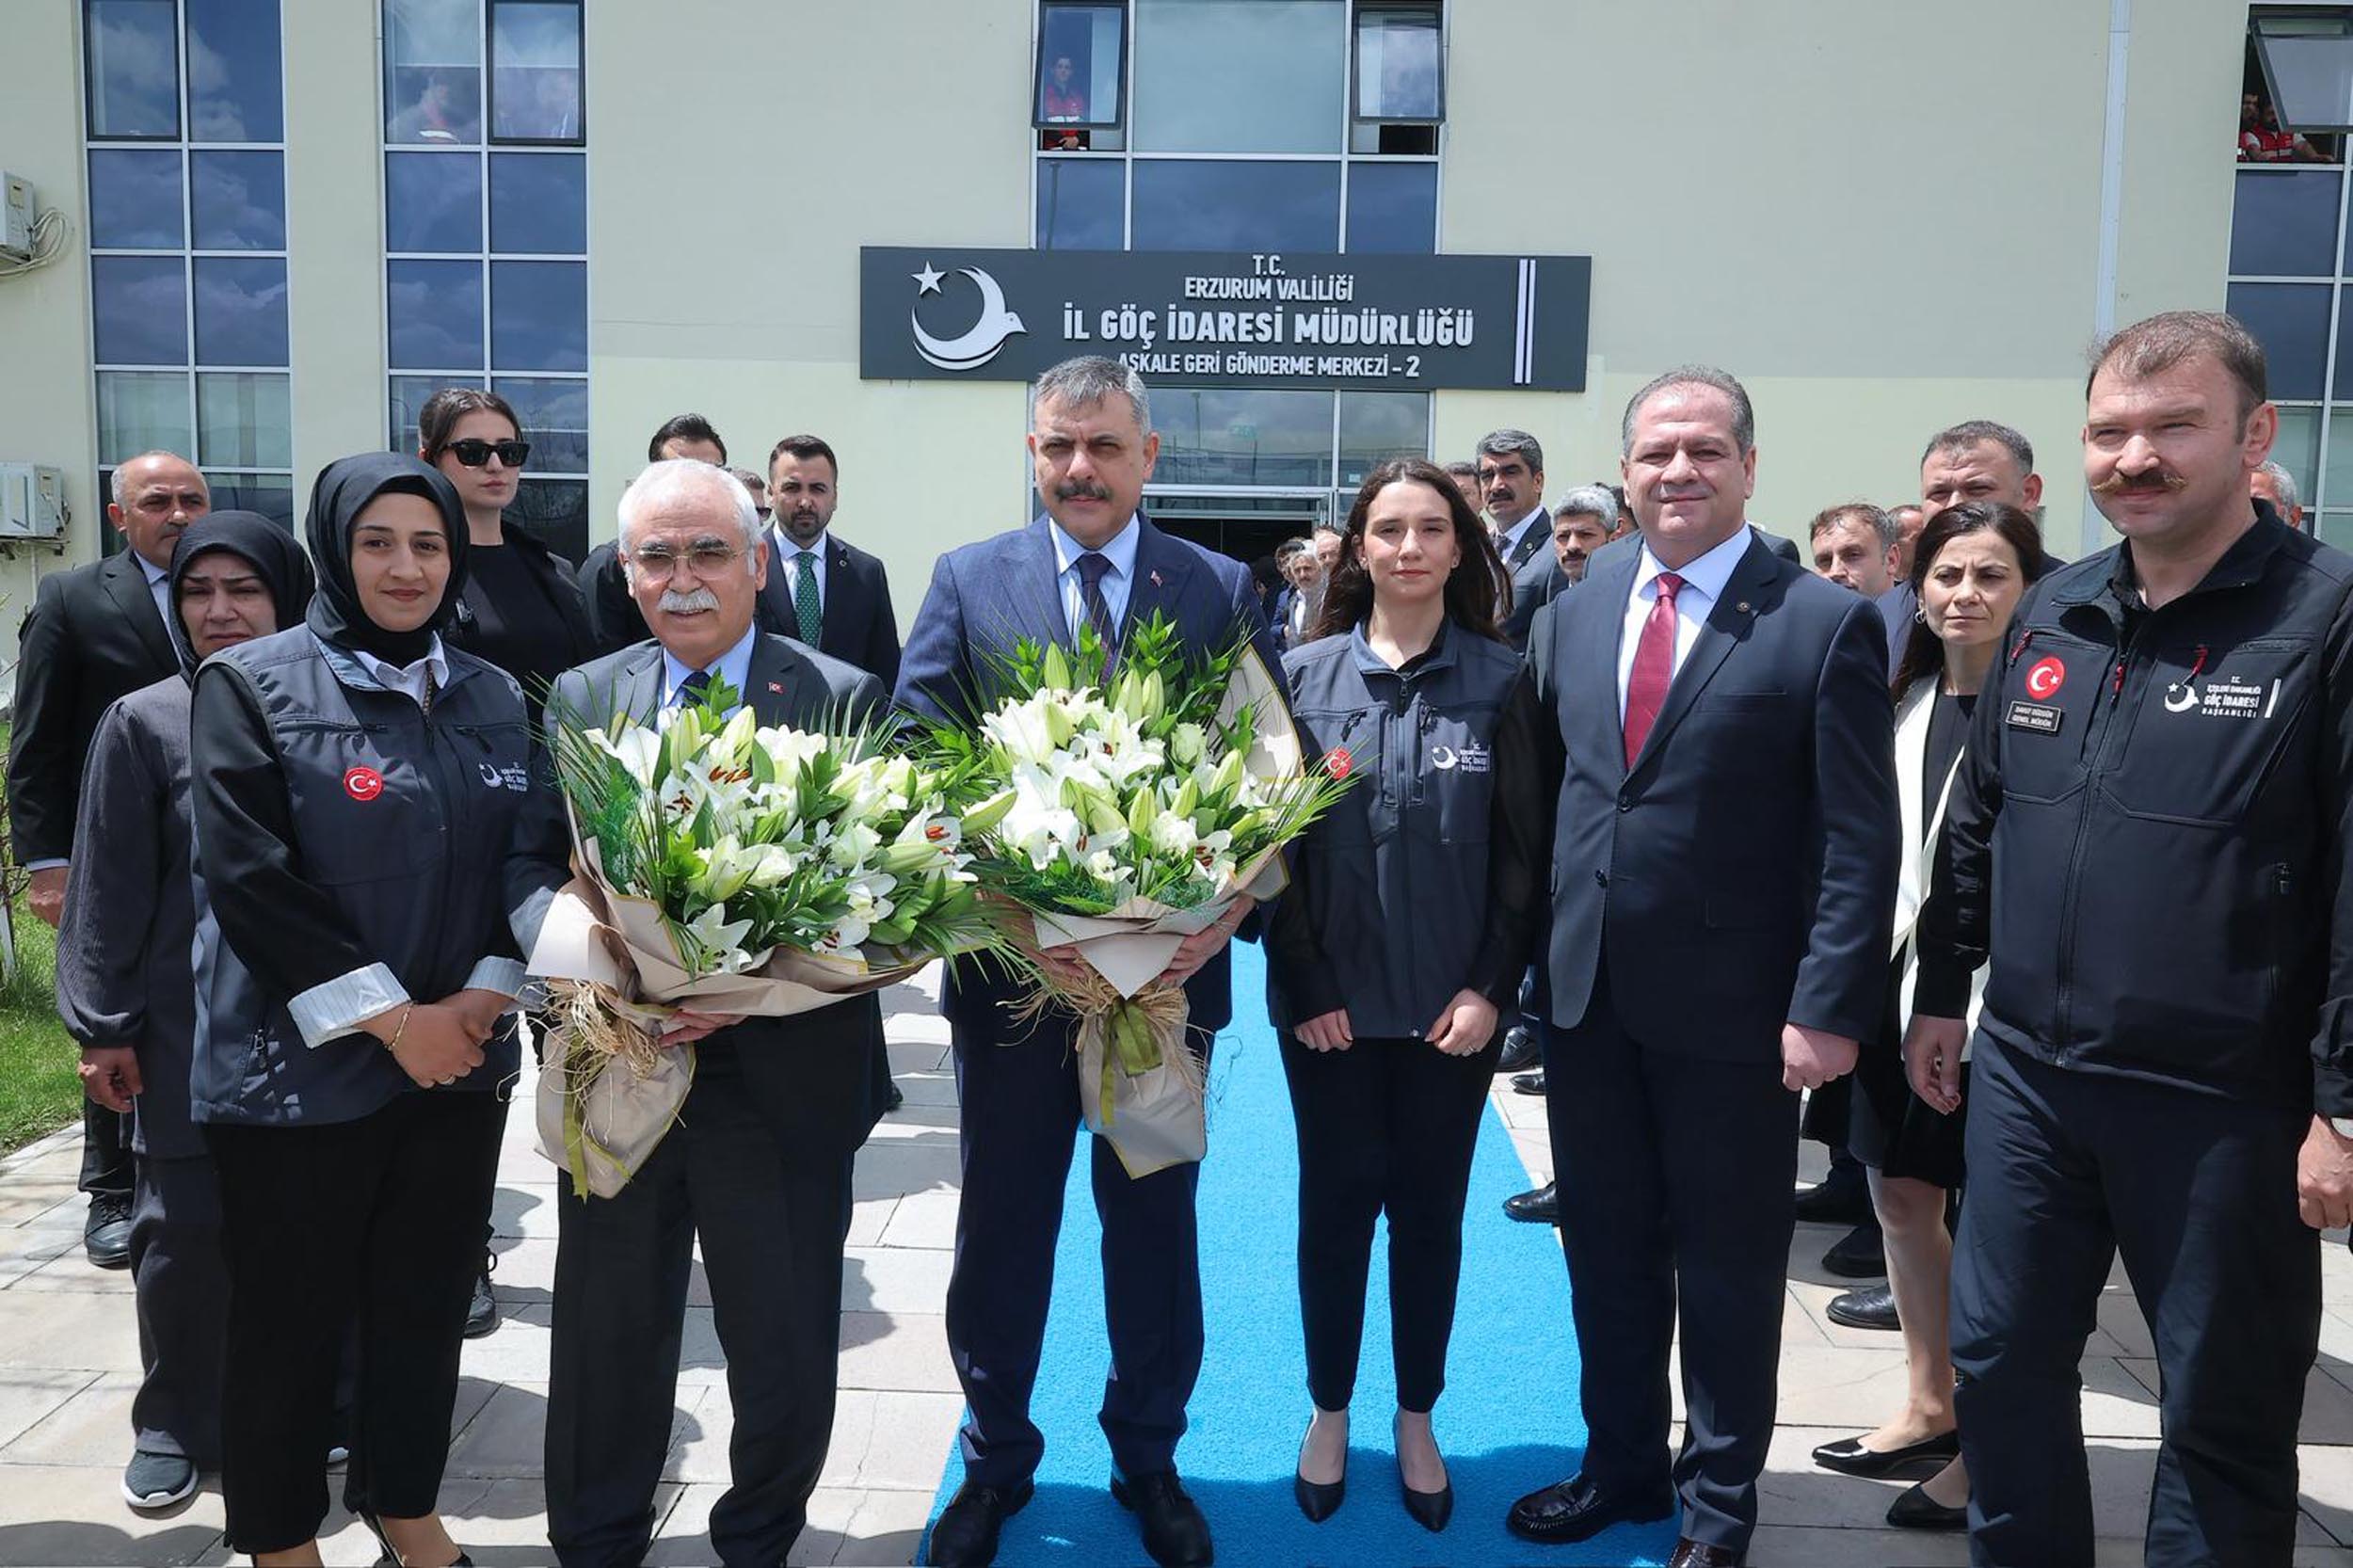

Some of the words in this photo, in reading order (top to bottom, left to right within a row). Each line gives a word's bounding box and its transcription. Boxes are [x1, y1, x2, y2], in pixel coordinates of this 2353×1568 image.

[1253, 255, 1286, 275] T.C.
[1184, 277, 1272, 299] ERZURUM
[1276, 274, 1353, 301] VALİLİĞİ
[1064, 302, 1090, 340] İL
[1100, 304, 1157, 349] GÖÇ
[1167, 304, 1283, 343] İDARESİ
[1294, 307, 1474, 346] MÜDÜRLÜĞÜ
[1184, 350, 1221, 374] GERİ
[1225, 351, 1314, 376] GÖNDERME
[1318, 354, 1388, 376] MERKEZİ
[1405, 355, 1420, 376] 2
[2204, 695, 2222, 708] GÖÇ
[2222, 694, 2260, 708] İDARESİ
